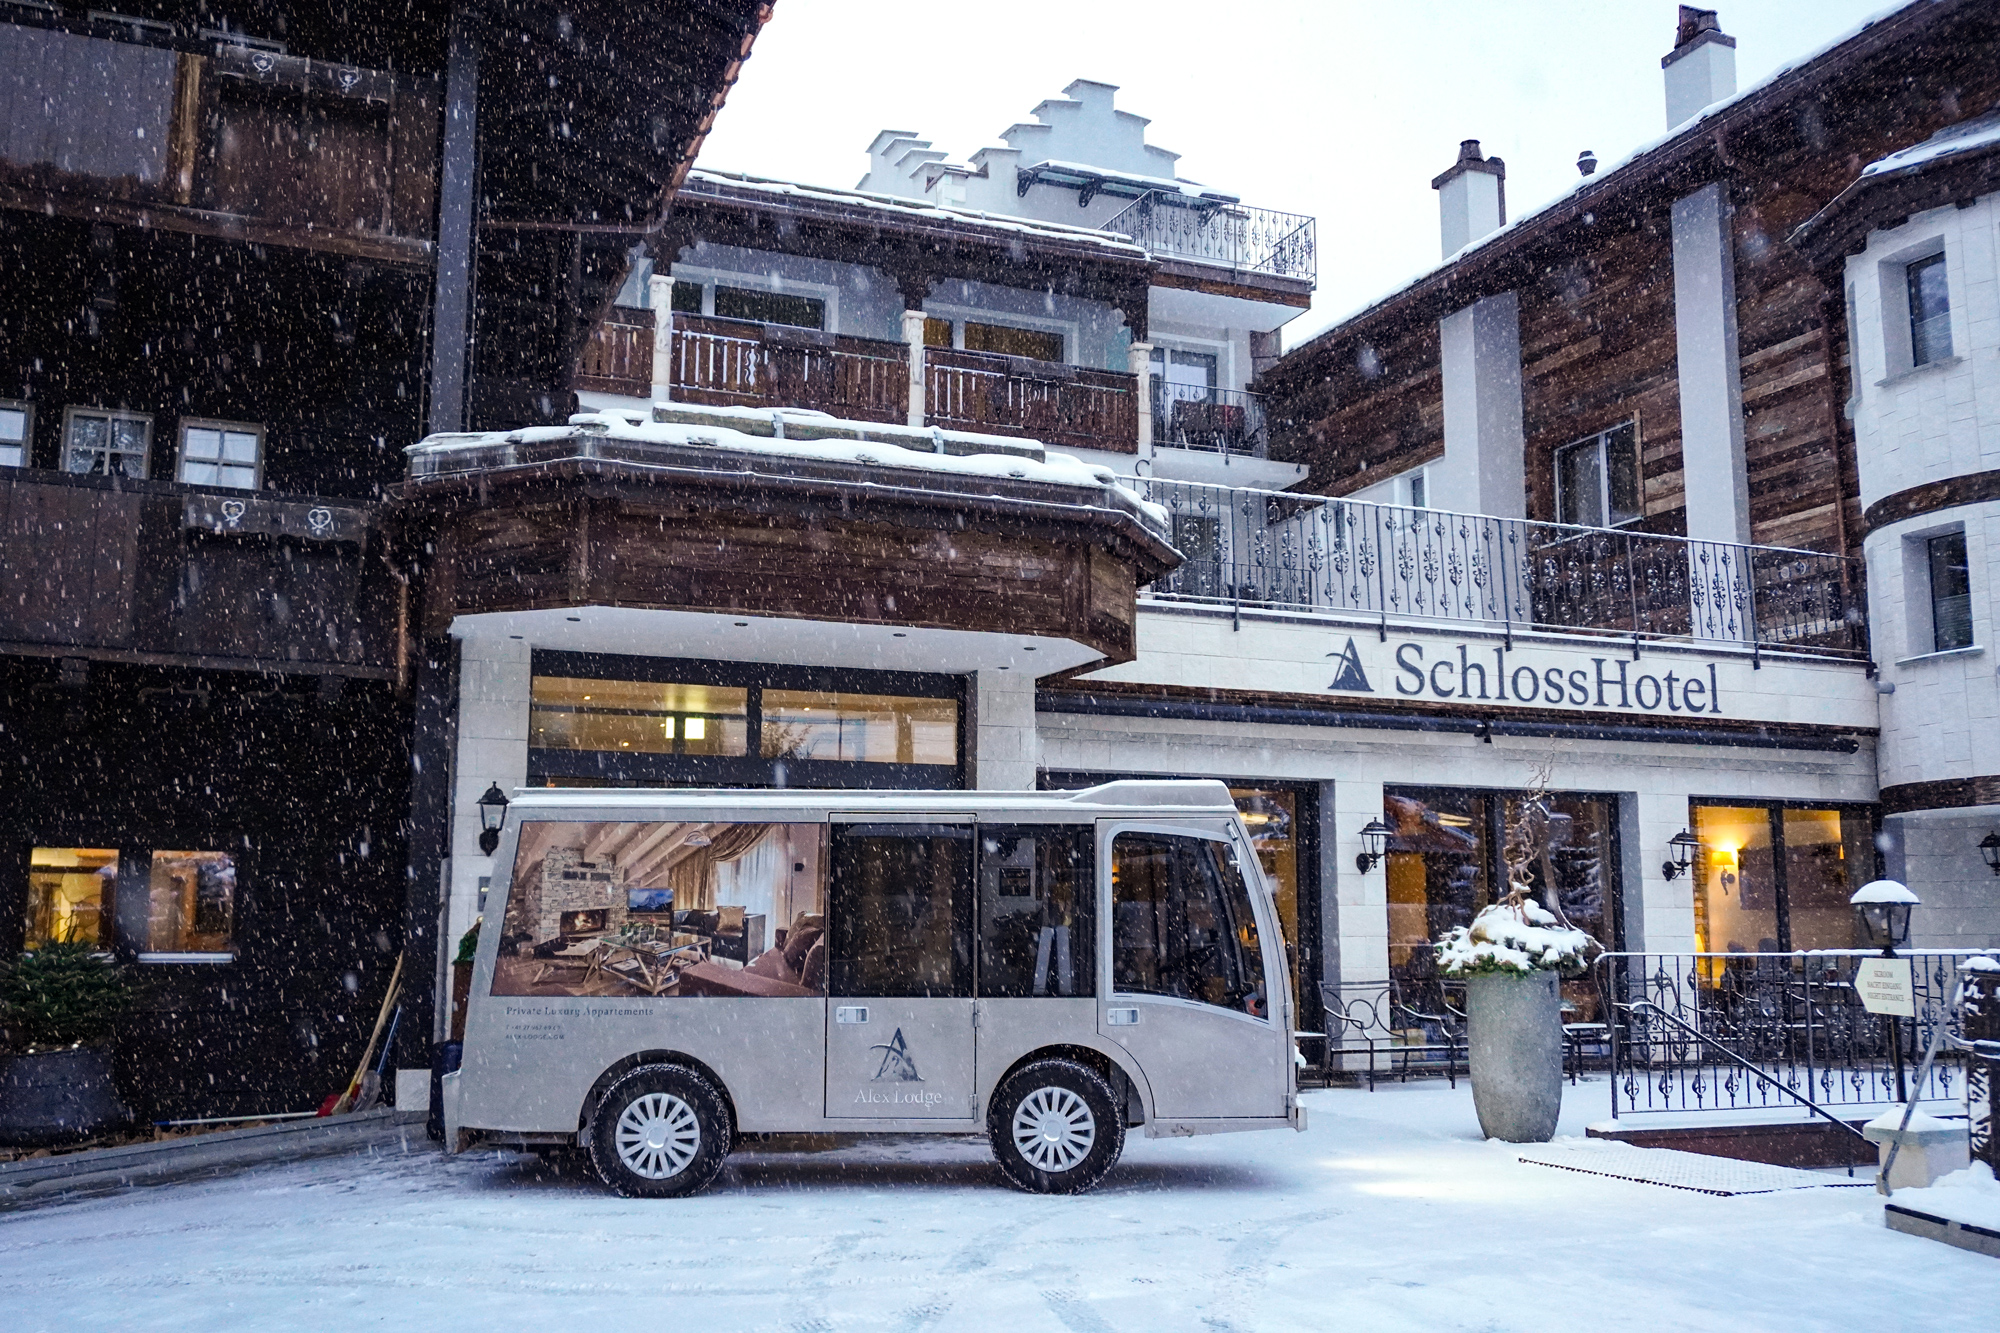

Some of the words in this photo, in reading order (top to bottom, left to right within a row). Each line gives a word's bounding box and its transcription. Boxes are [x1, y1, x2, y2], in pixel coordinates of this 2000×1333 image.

[1395, 642, 1723, 714] SchlossHotel
[506, 1006, 542, 1016] Private
[544, 1006, 580, 1017] Luxury
[583, 1006, 654, 1017] Appartements
[854, 1089, 890, 1104] Alex
[895, 1089, 942, 1108] Lodge
